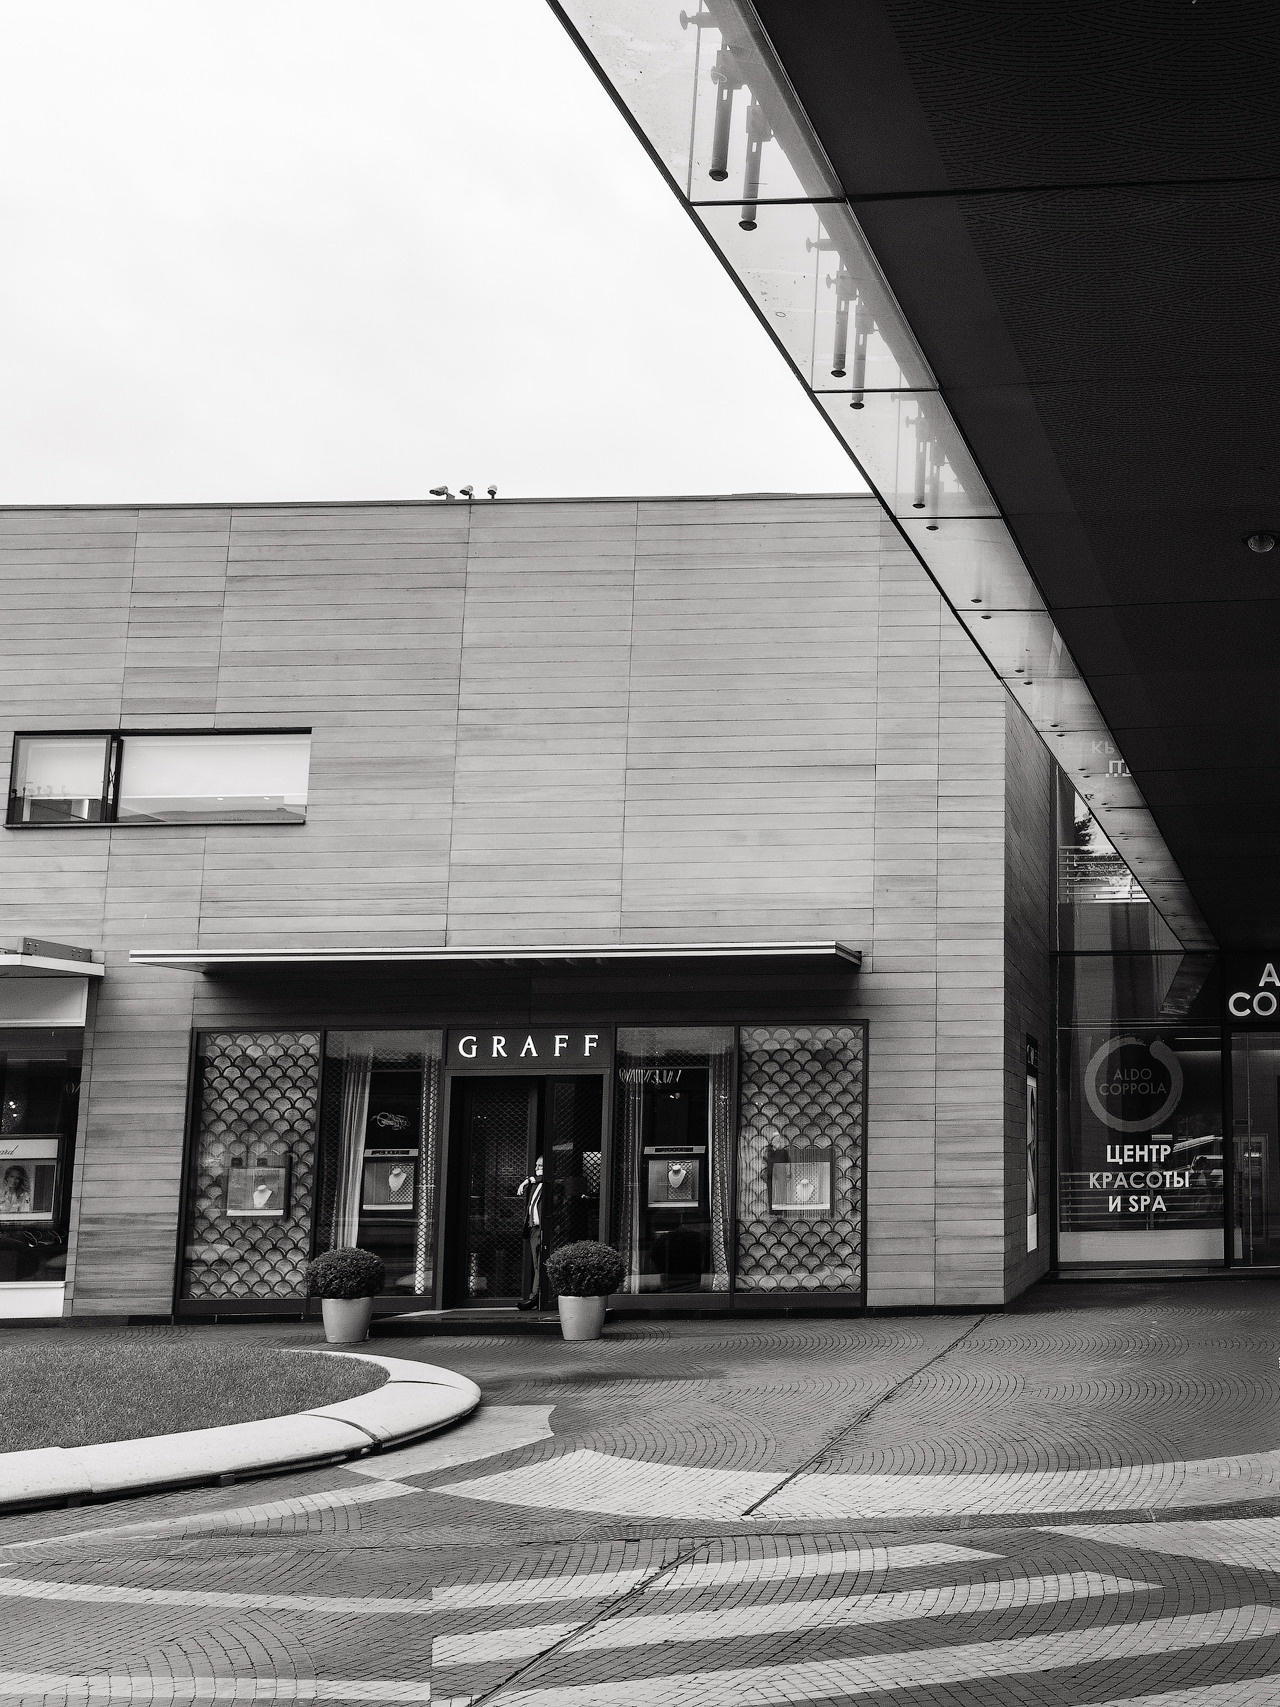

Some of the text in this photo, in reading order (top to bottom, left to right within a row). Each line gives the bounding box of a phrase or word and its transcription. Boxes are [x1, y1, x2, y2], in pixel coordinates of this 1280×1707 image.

[458, 1034, 599, 1058] GRAFF
[1113, 1068, 1153, 1081] ALDO
[1100, 1082, 1167, 1096] COPPOLA
[1106, 1144, 1172, 1165] ЦЕНТР
[1089, 1171, 1190, 1189] КРАСОТЫ
[1108, 1195, 1167, 1213] И SPA
